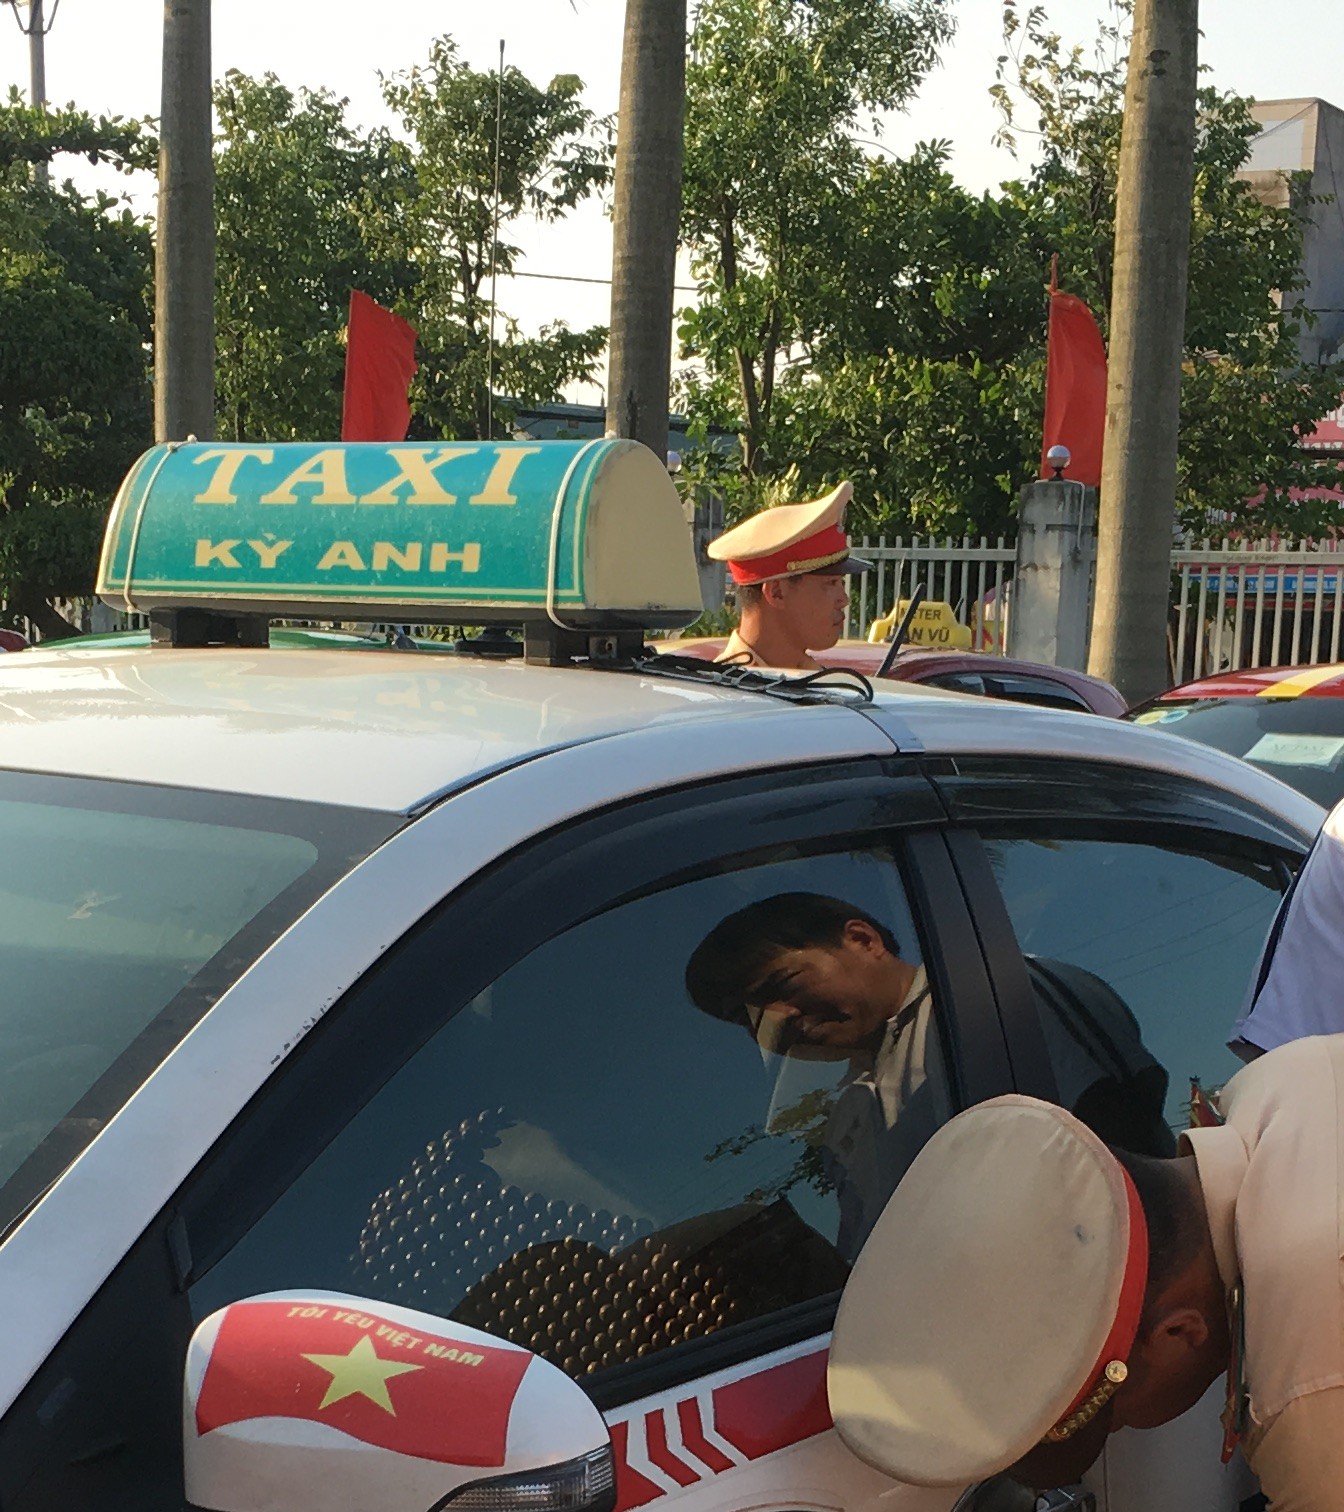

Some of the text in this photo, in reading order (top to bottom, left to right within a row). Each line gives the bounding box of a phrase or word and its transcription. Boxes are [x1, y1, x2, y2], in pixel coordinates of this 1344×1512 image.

[193, 447, 541, 504] TAXI
[316, 541, 481, 573] ANH
[287, 1305, 485, 1367] TÔI YÊU VIỆT NAM
